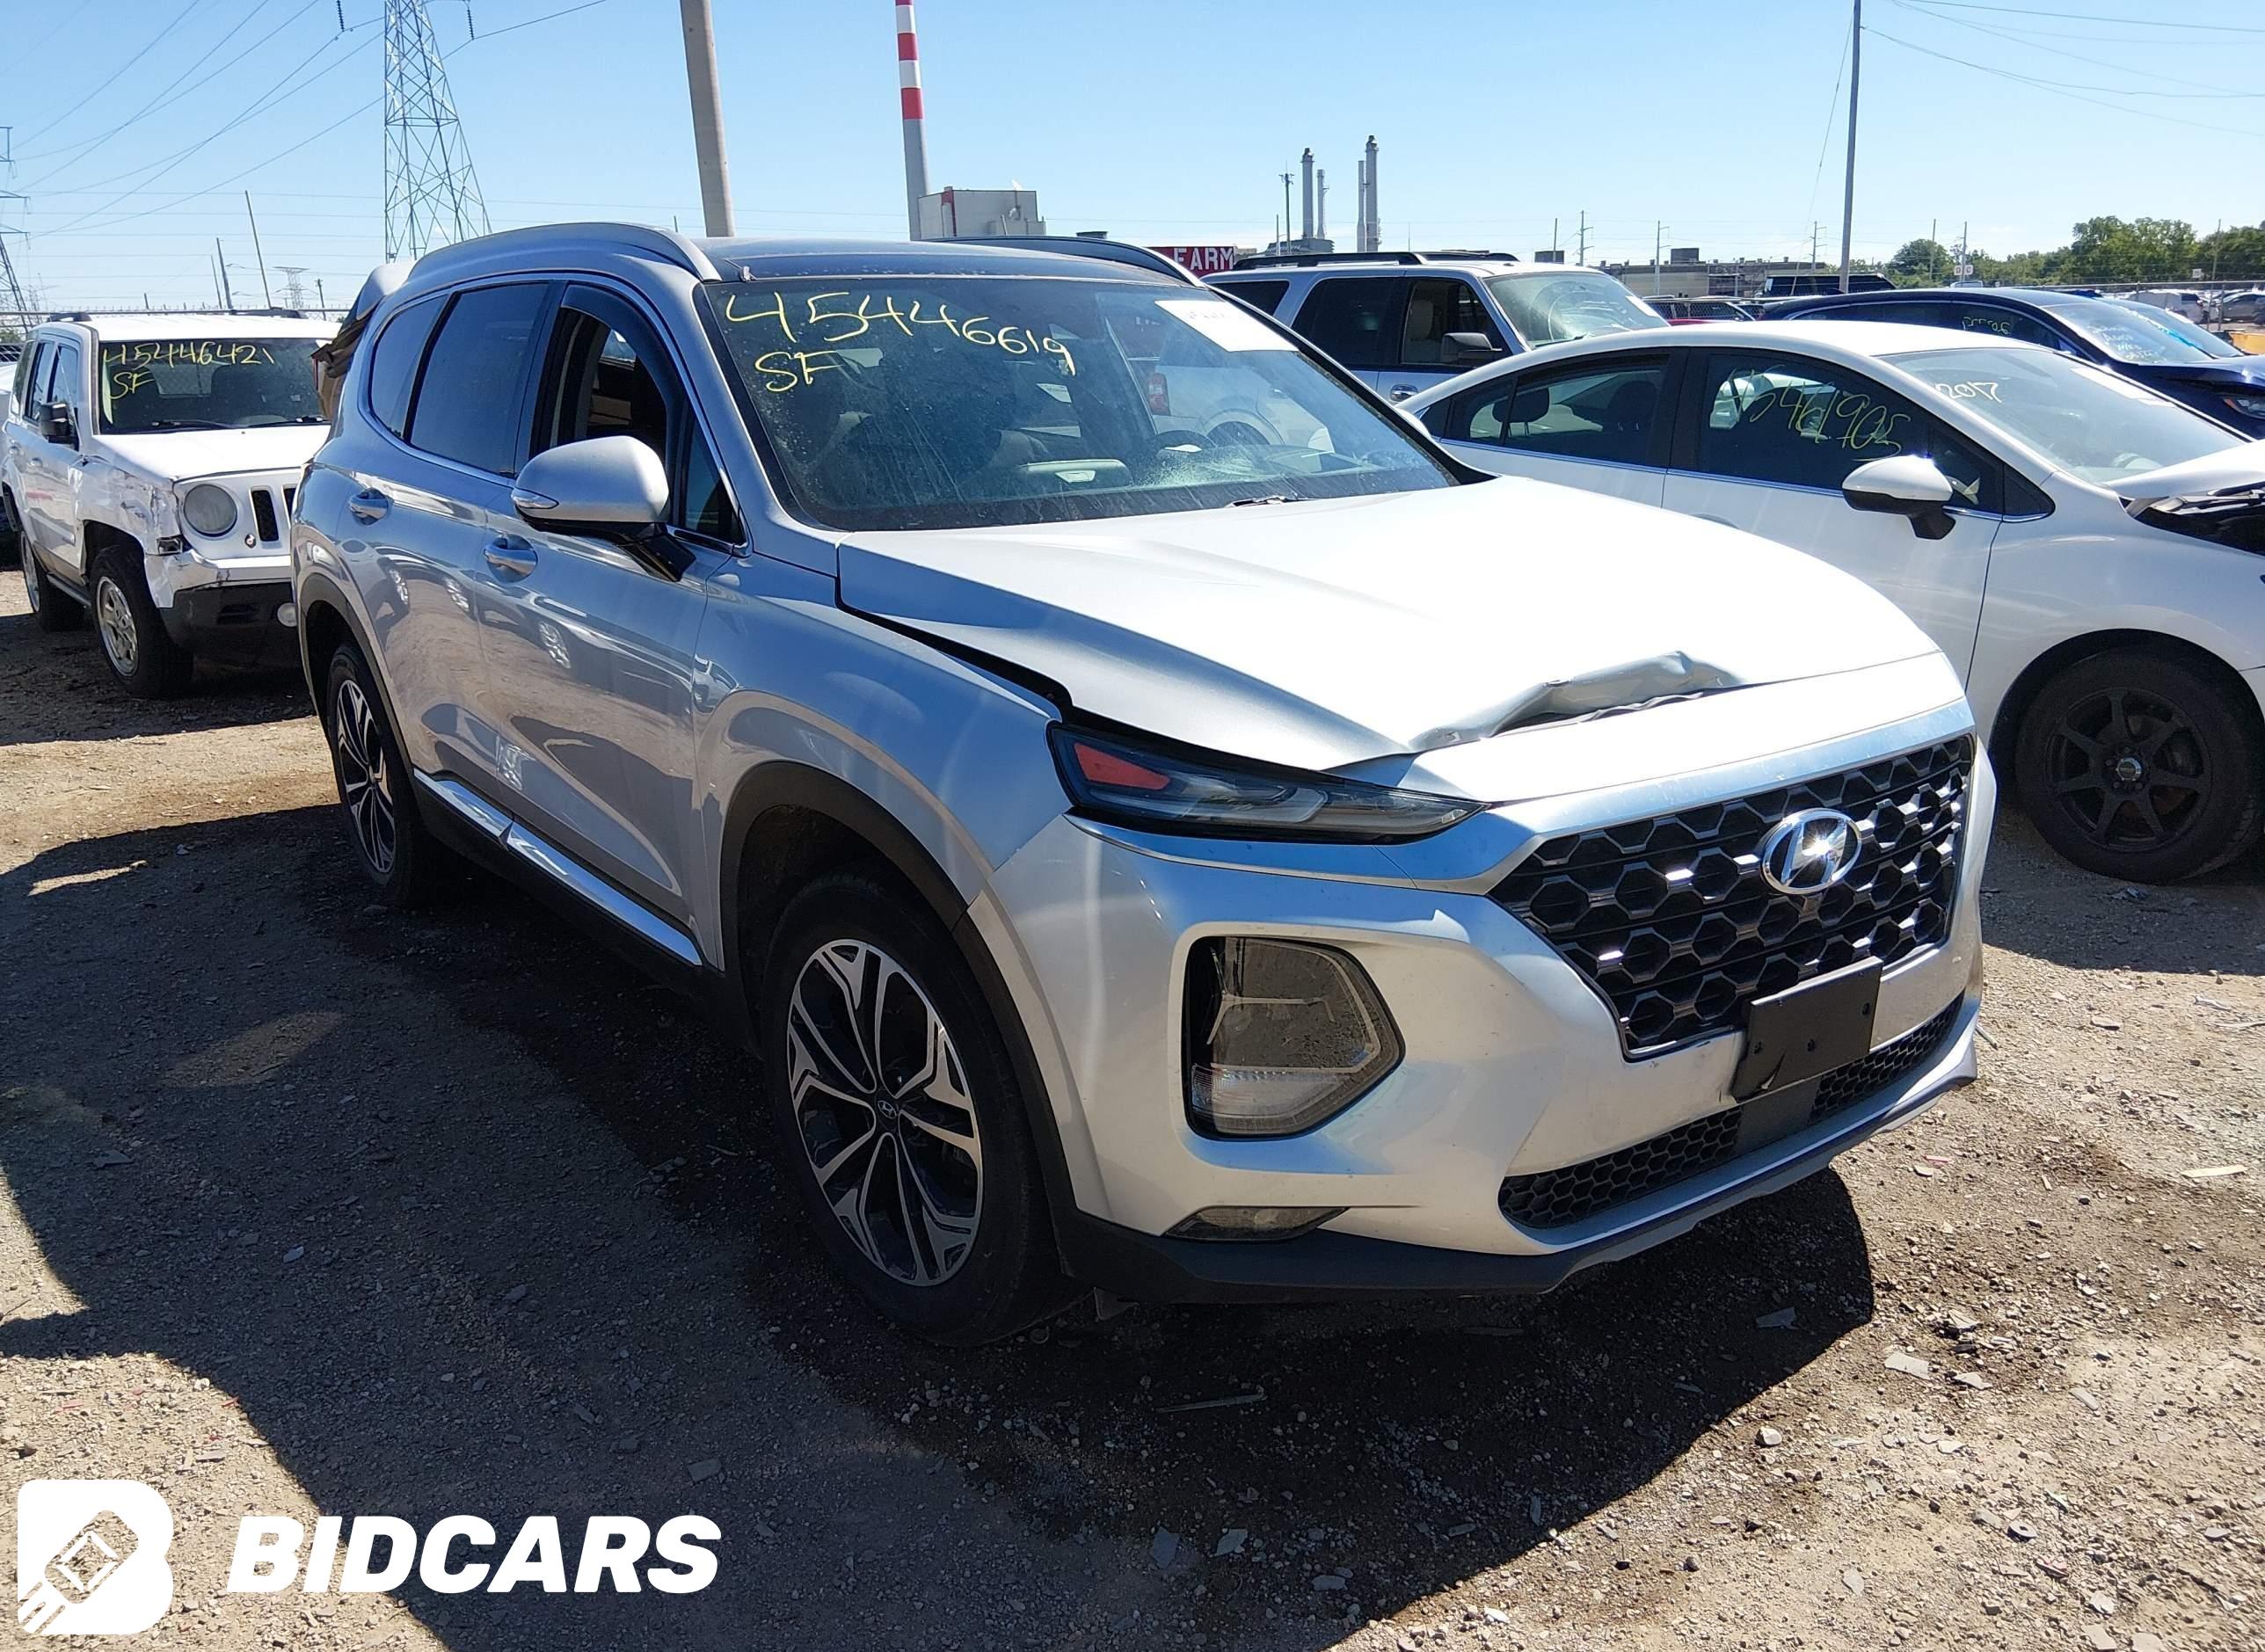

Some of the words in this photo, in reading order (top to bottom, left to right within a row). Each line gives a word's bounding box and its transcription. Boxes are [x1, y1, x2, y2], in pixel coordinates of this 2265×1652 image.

[1174, 247, 1234, 270] FARM
[726, 291, 1077, 377] 45446619
[103, 340, 275, 371] 45446421
[109, 371, 157, 399] SF
[754, 350, 843, 393] SF
[1935, 380, 2003, 404] 2017
